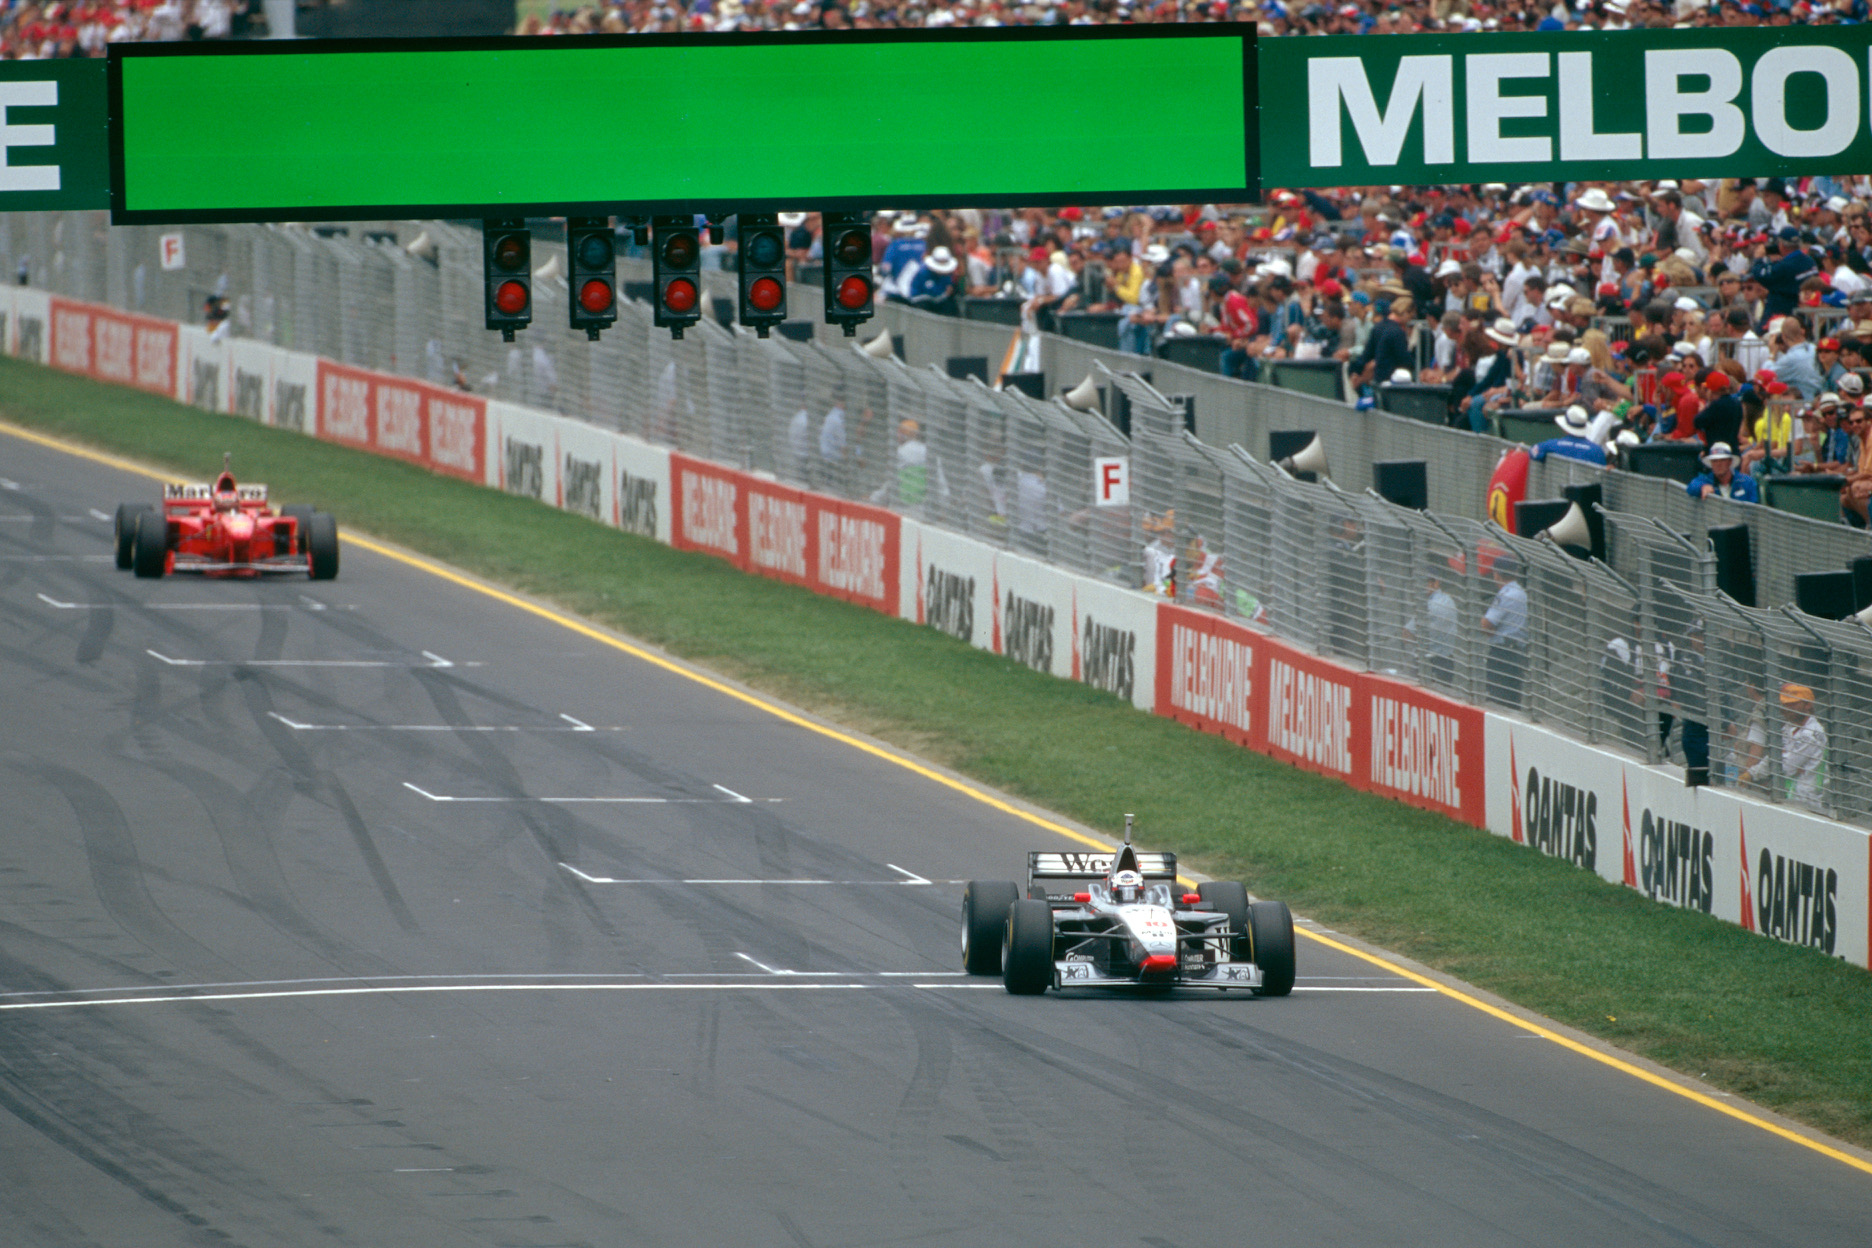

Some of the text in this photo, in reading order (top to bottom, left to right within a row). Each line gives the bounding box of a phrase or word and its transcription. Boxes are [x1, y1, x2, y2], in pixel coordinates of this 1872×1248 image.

[1308, 45, 1872, 167] MELBO
[165, 238, 179, 264] F
[168, 484, 263, 499] Marlro
[1102, 463, 1121, 499] F
[1171, 622, 1461, 809] MELBOURNE MELBOURNE MELBOURNE
[1060, 853, 1114, 873] We
[1525, 766, 1838, 955] QANTAS QANTAS QANTAS
